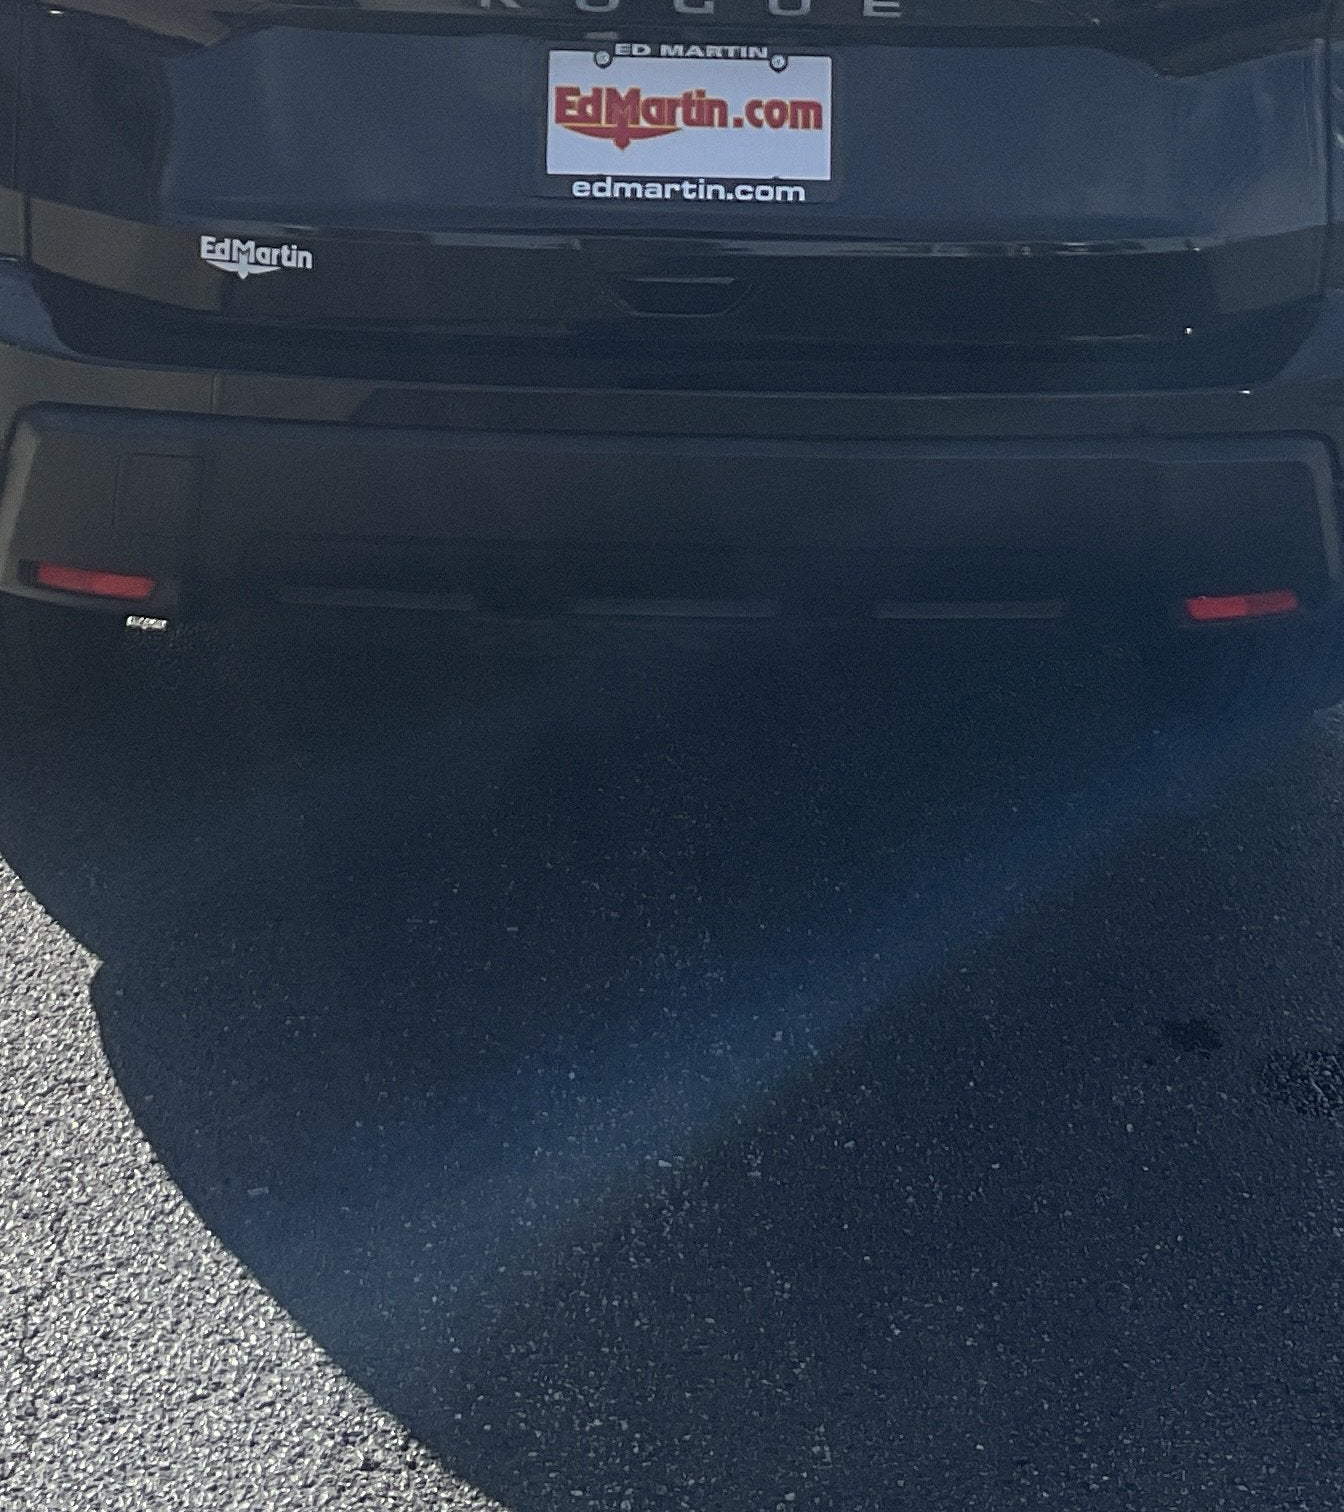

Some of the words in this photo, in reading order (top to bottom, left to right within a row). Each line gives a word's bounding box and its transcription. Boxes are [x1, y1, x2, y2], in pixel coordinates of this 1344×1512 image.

[614, 43, 651, 56] ED
[660, 44, 768, 58] MARTIN
[555, 86, 824, 131] EdMartin.com
[571, 176, 806, 202] edmartin.com
[200, 235, 313, 270] EdMartin
